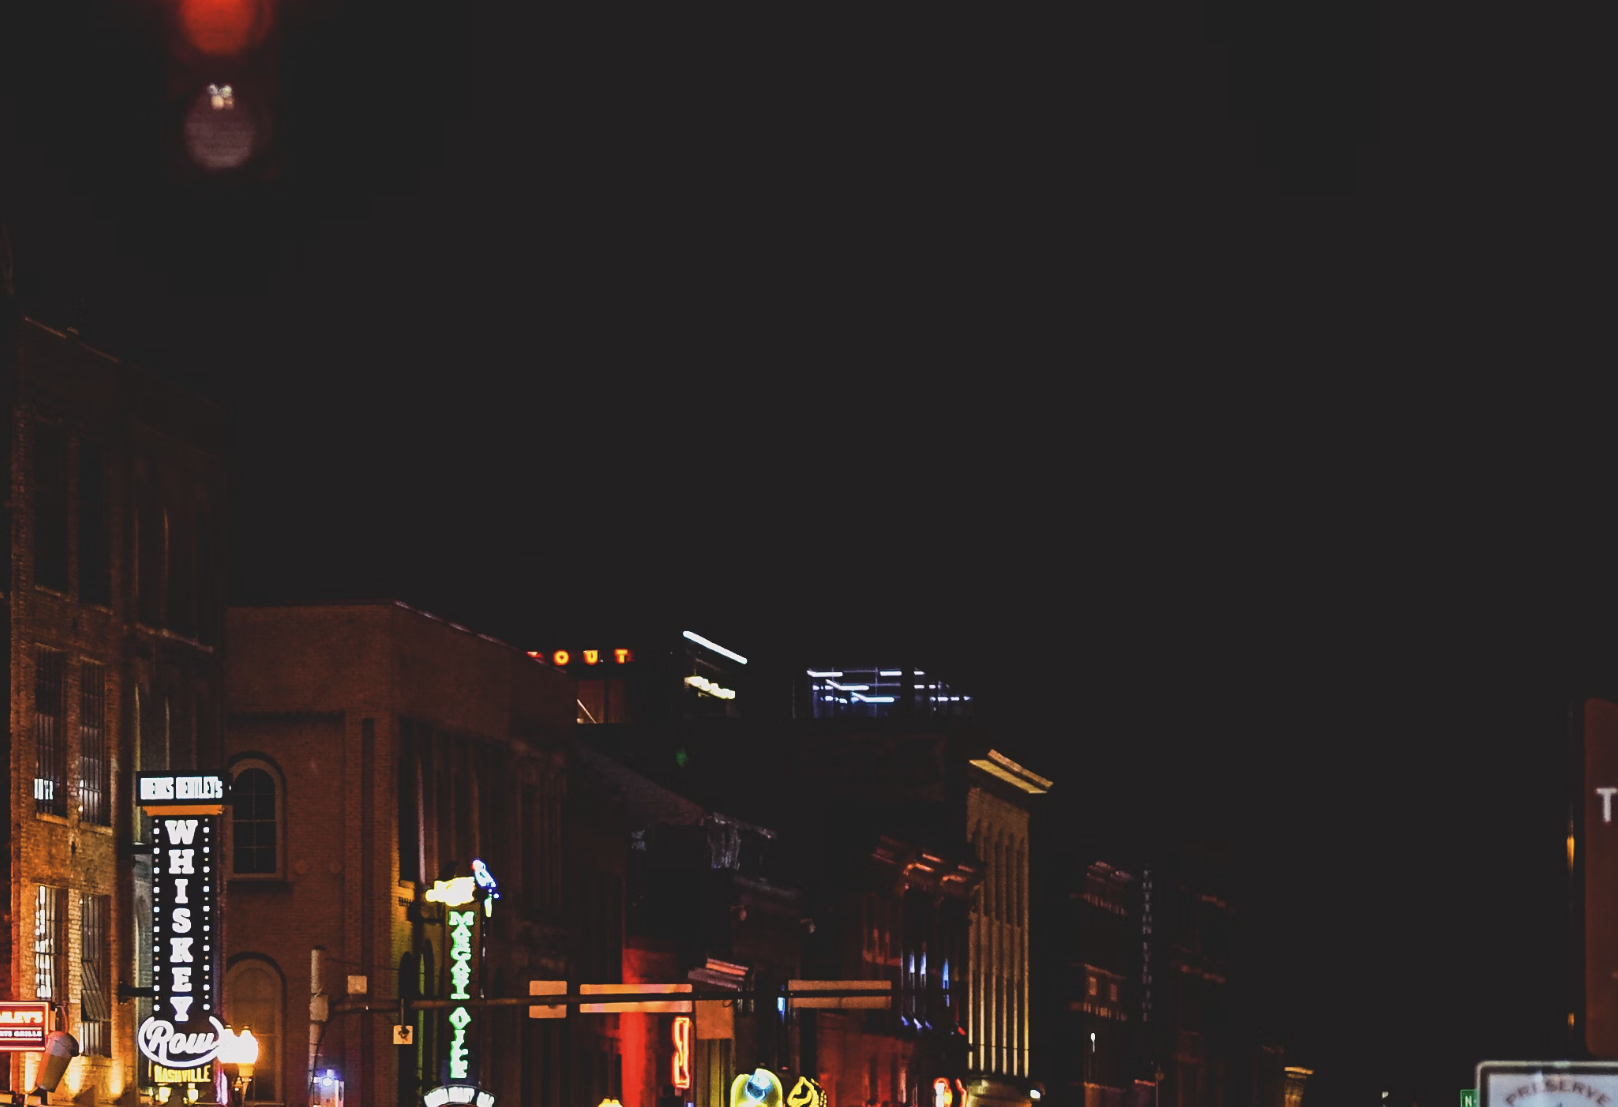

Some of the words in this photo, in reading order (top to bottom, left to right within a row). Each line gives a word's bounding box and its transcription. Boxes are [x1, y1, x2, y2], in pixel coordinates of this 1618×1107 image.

[165, 819, 198, 1022] WHISKEY
[146, 1019, 219, 1061] Row
[154, 1064, 211, 1083] NASHVILLE
